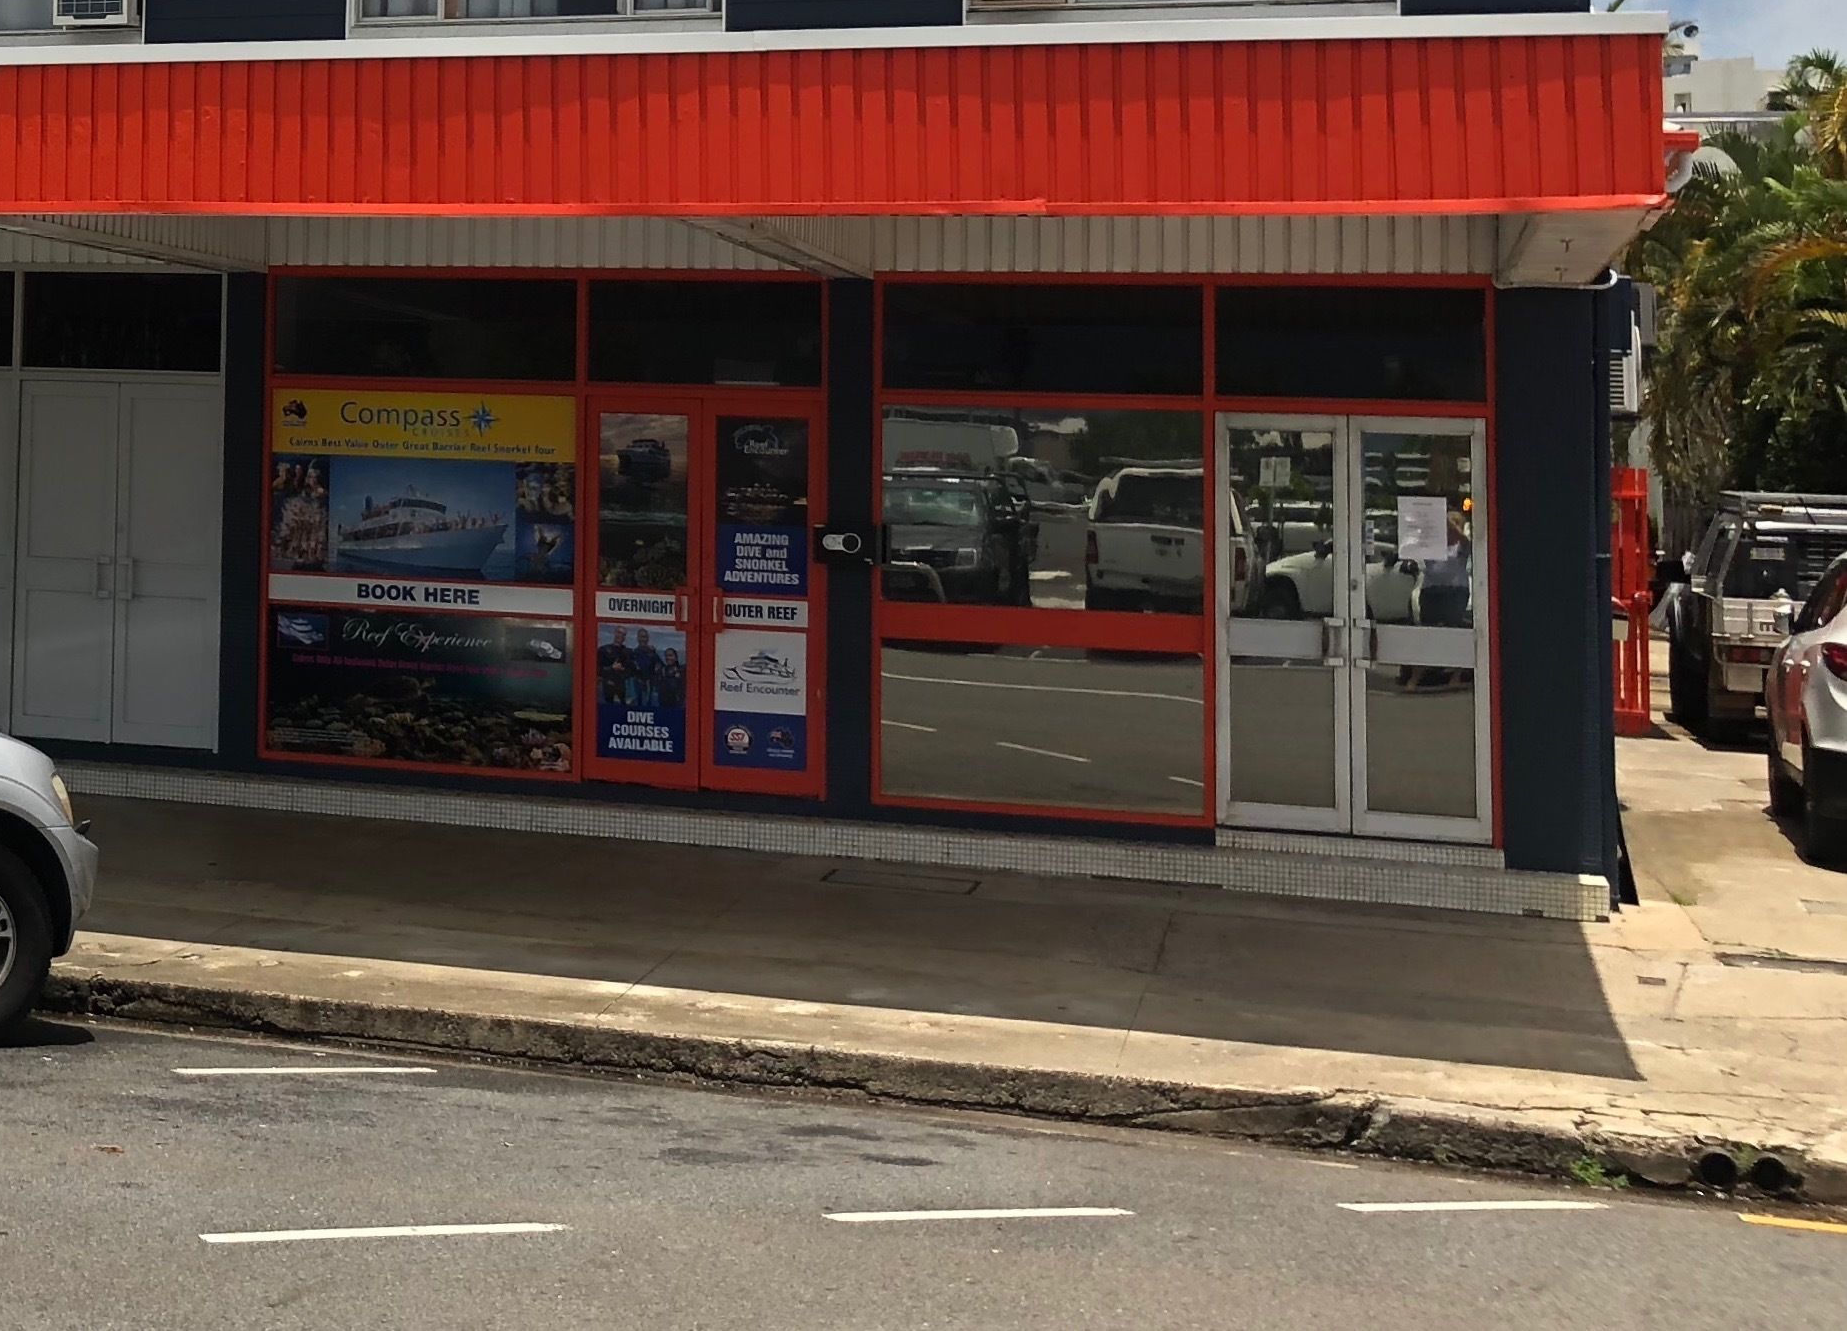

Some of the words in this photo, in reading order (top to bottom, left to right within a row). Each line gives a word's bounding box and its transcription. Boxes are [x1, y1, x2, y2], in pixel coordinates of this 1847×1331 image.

[340, 401, 461, 432] Compass
[321, 437, 342, 447] Best
[344, 438, 369, 449] Value
[372, 440, 399, 450] Outer
[402, 440, 431, 451] Great
[432, 442, 467, 452] Barrier
[493, 443, 531, 455] Snorkel
[734, 532, 790, 547] AMAZING
[736, 545, 762, 559] DIVE
[765, 547, 788, 560] and
[735, 558, 790, 572] SNORKEL
[724, 571, 800, 586] ADVENTURES
[357, 583, 416, 602] BOOK
[423, 587, 480, 605] HERE
[608, 597, 674, 615] OVERNIGHT
[724, 603, 763, 619] OUTER
[767, 605, 798, 621] REEF
[342, 617, 395, 647] Reef
[394, 622, 492, 653] Experience
[720, 681, 743, 693] Reef
[746, 683, 800, 696] Encounter
[627, 710, 654, 725] DIVE
[612, 723, 670, 739] COURSES
[608, 737, 674, 753] AVAILABLE
